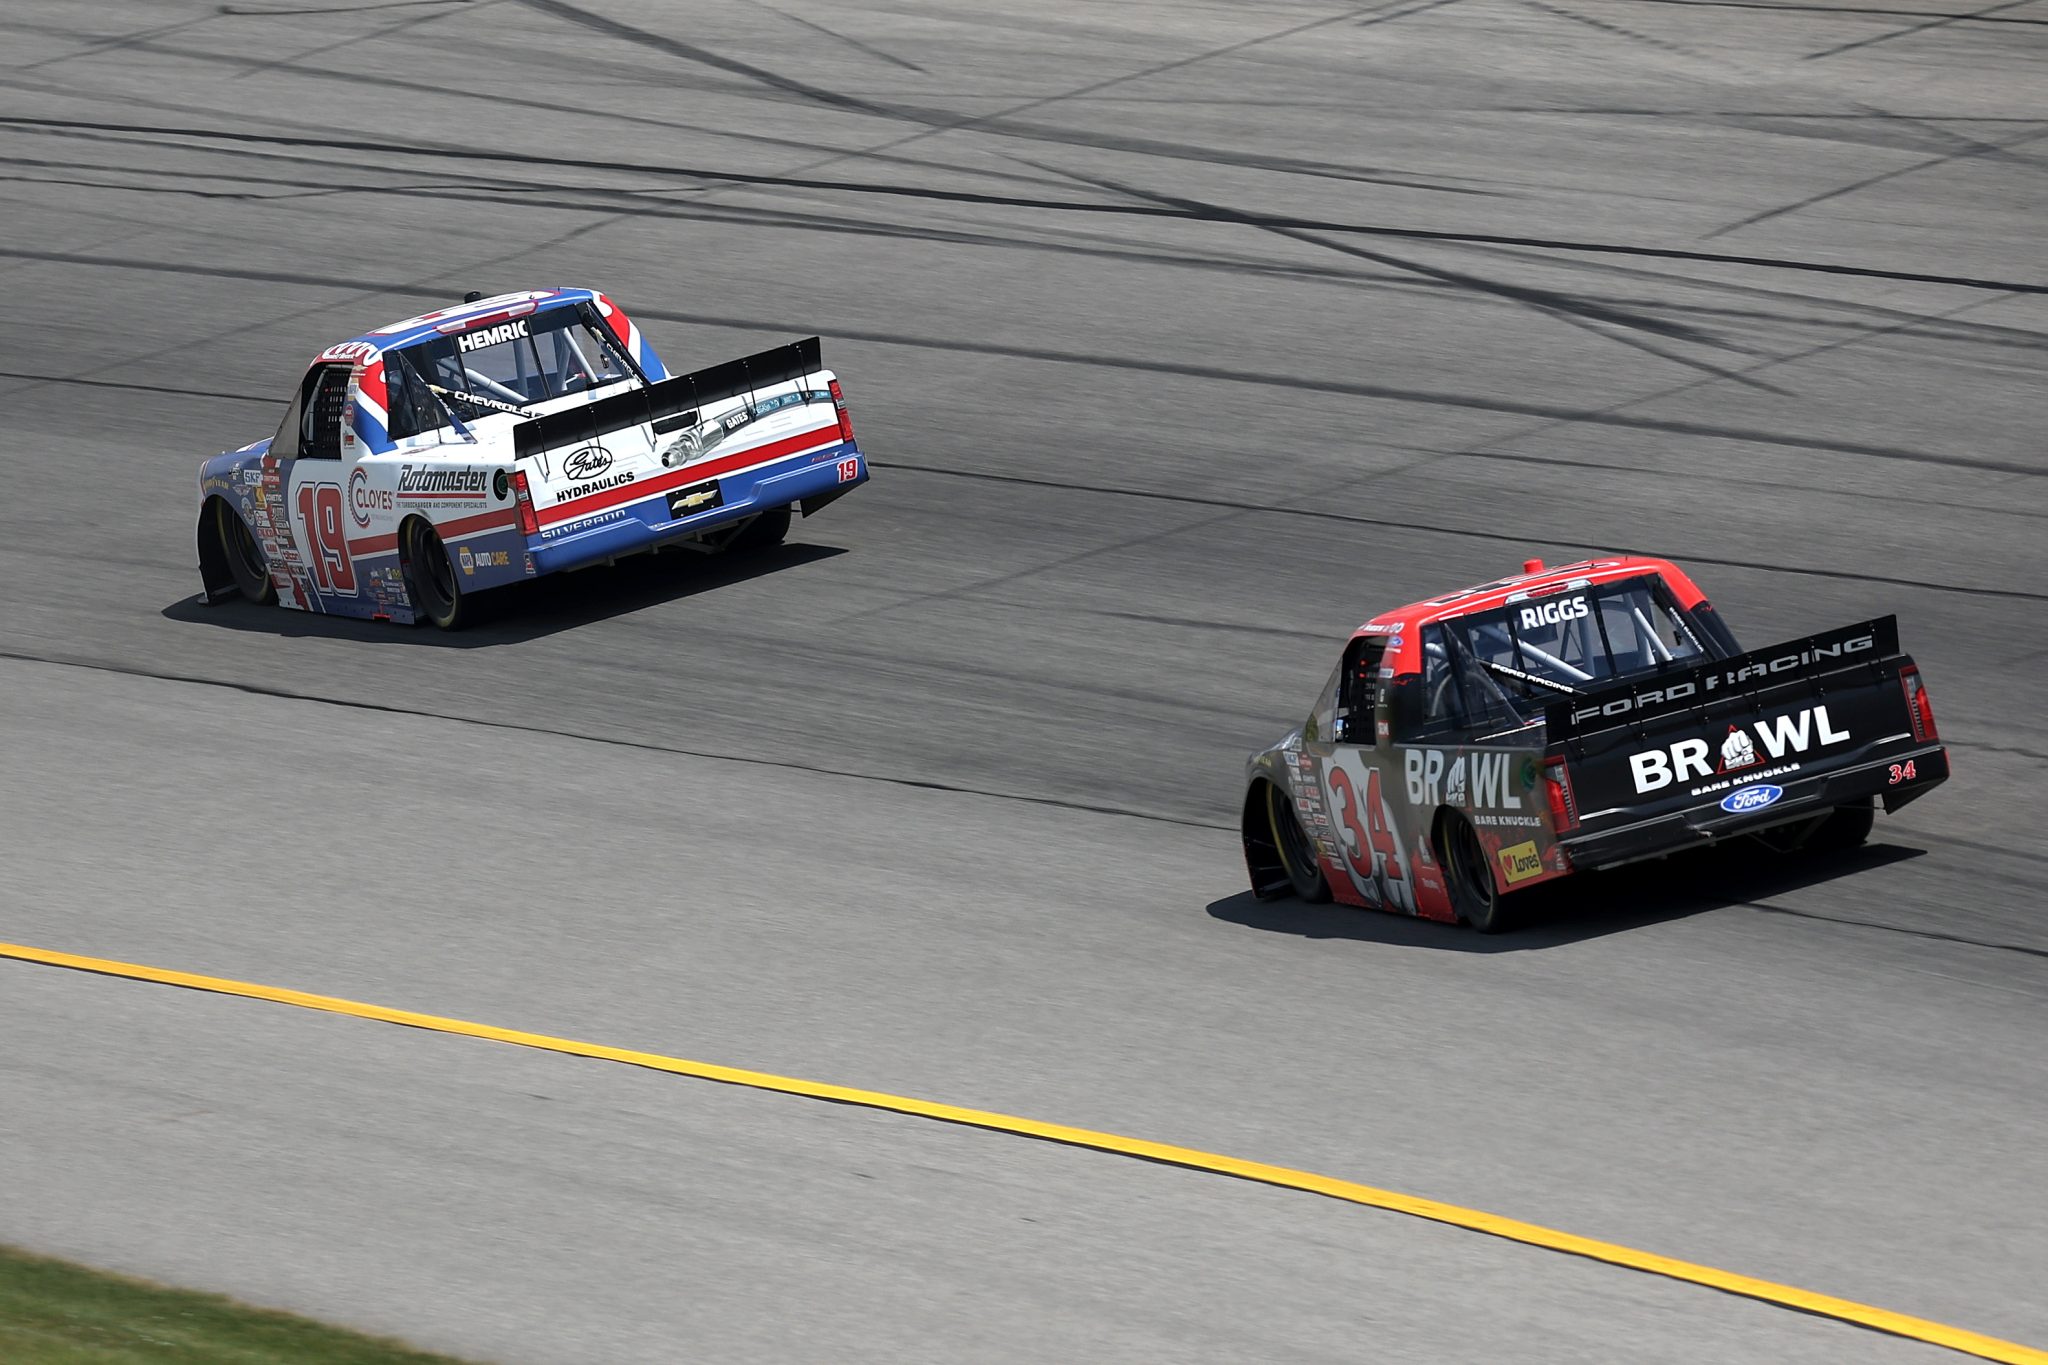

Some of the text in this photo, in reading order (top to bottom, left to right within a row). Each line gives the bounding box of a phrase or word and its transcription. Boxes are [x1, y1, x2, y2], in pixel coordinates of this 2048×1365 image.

[458, 320, 528, 352] HEMRIC
[455, 391, 539, 417] CHEVROLET
[726, 412, 748, 429] GATES
[245, 472, 260, 482] SKF
[398, 464, 487, 491] Rotomaster
[568, 451, 608, 480] Gates
[837, 457, 858, 483] 19
[356, 488, 392, 510] CLOYES
[557, 472, 634, 502] HYDRAULICS
[541, 509, 625, 539] SILVERADO
[296, 482, 358, 597] 19
[475, 553, 491, 567] AUTO
[491, 552, 509, 566] CARE
[1521, 596, 1588, 630] RIGGS
[1491, 663, 1573, 693] FORD RACING
[1571, 635, 1873, 725] FORD RACING
[1692, 763, 1801, 796] BARE KNUCKLE
[1889, 760, 1916, 785] 34
[1734, 789, 1771, 809] Ford
[1329, 765, 1403, 881] 34
[1474, 815, 1541, 827] BARE KNUCKLE
